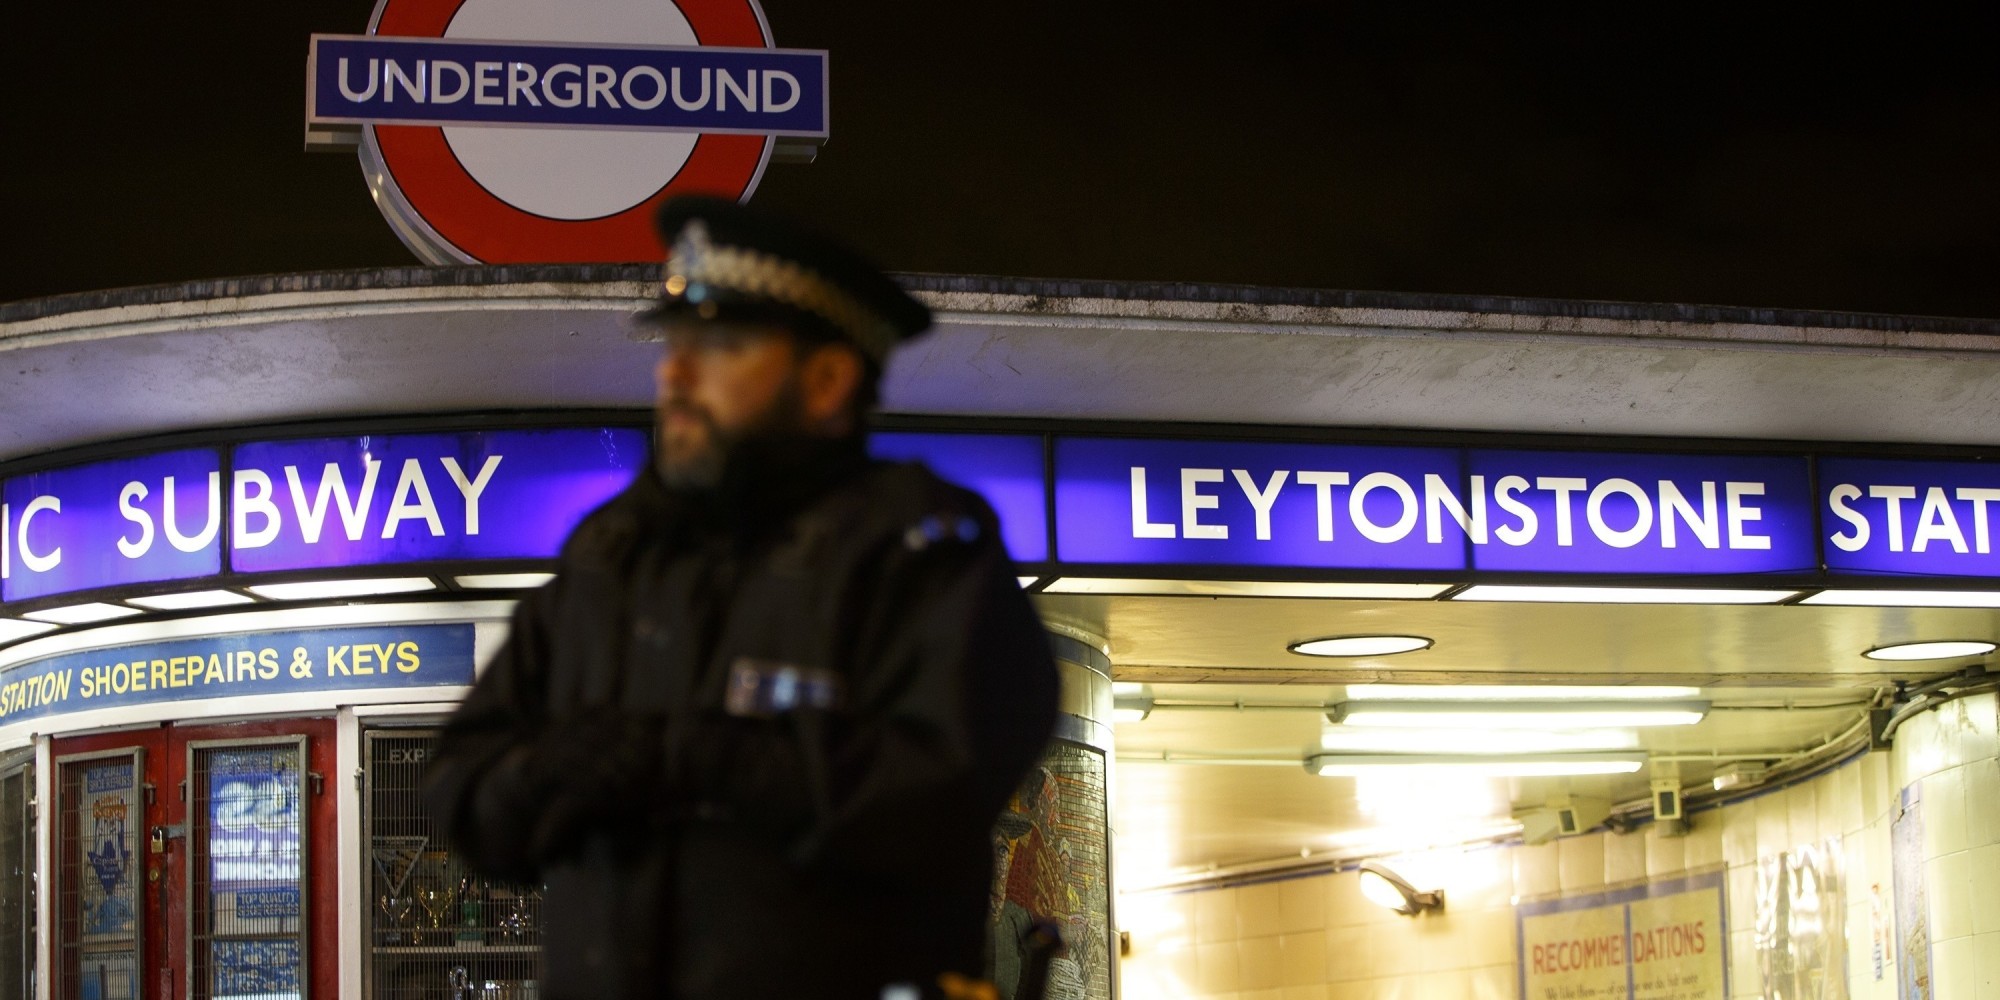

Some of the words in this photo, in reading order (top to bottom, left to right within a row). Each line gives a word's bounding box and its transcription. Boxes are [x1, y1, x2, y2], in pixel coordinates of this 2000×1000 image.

[338, 57, 801, 114] UNDERGROUND
[117, 455, 503, 559] SUBWAY
[1130, 466, 1771, 550] LEYTONSTONE
[1829, 483, 2000, 554] STAT
[0, 668, 72, 717] STATION
[290, 647, 313, 678] &
[327, 641, 420, 677] KEYS
[389, 748, 432, 763] EXP
